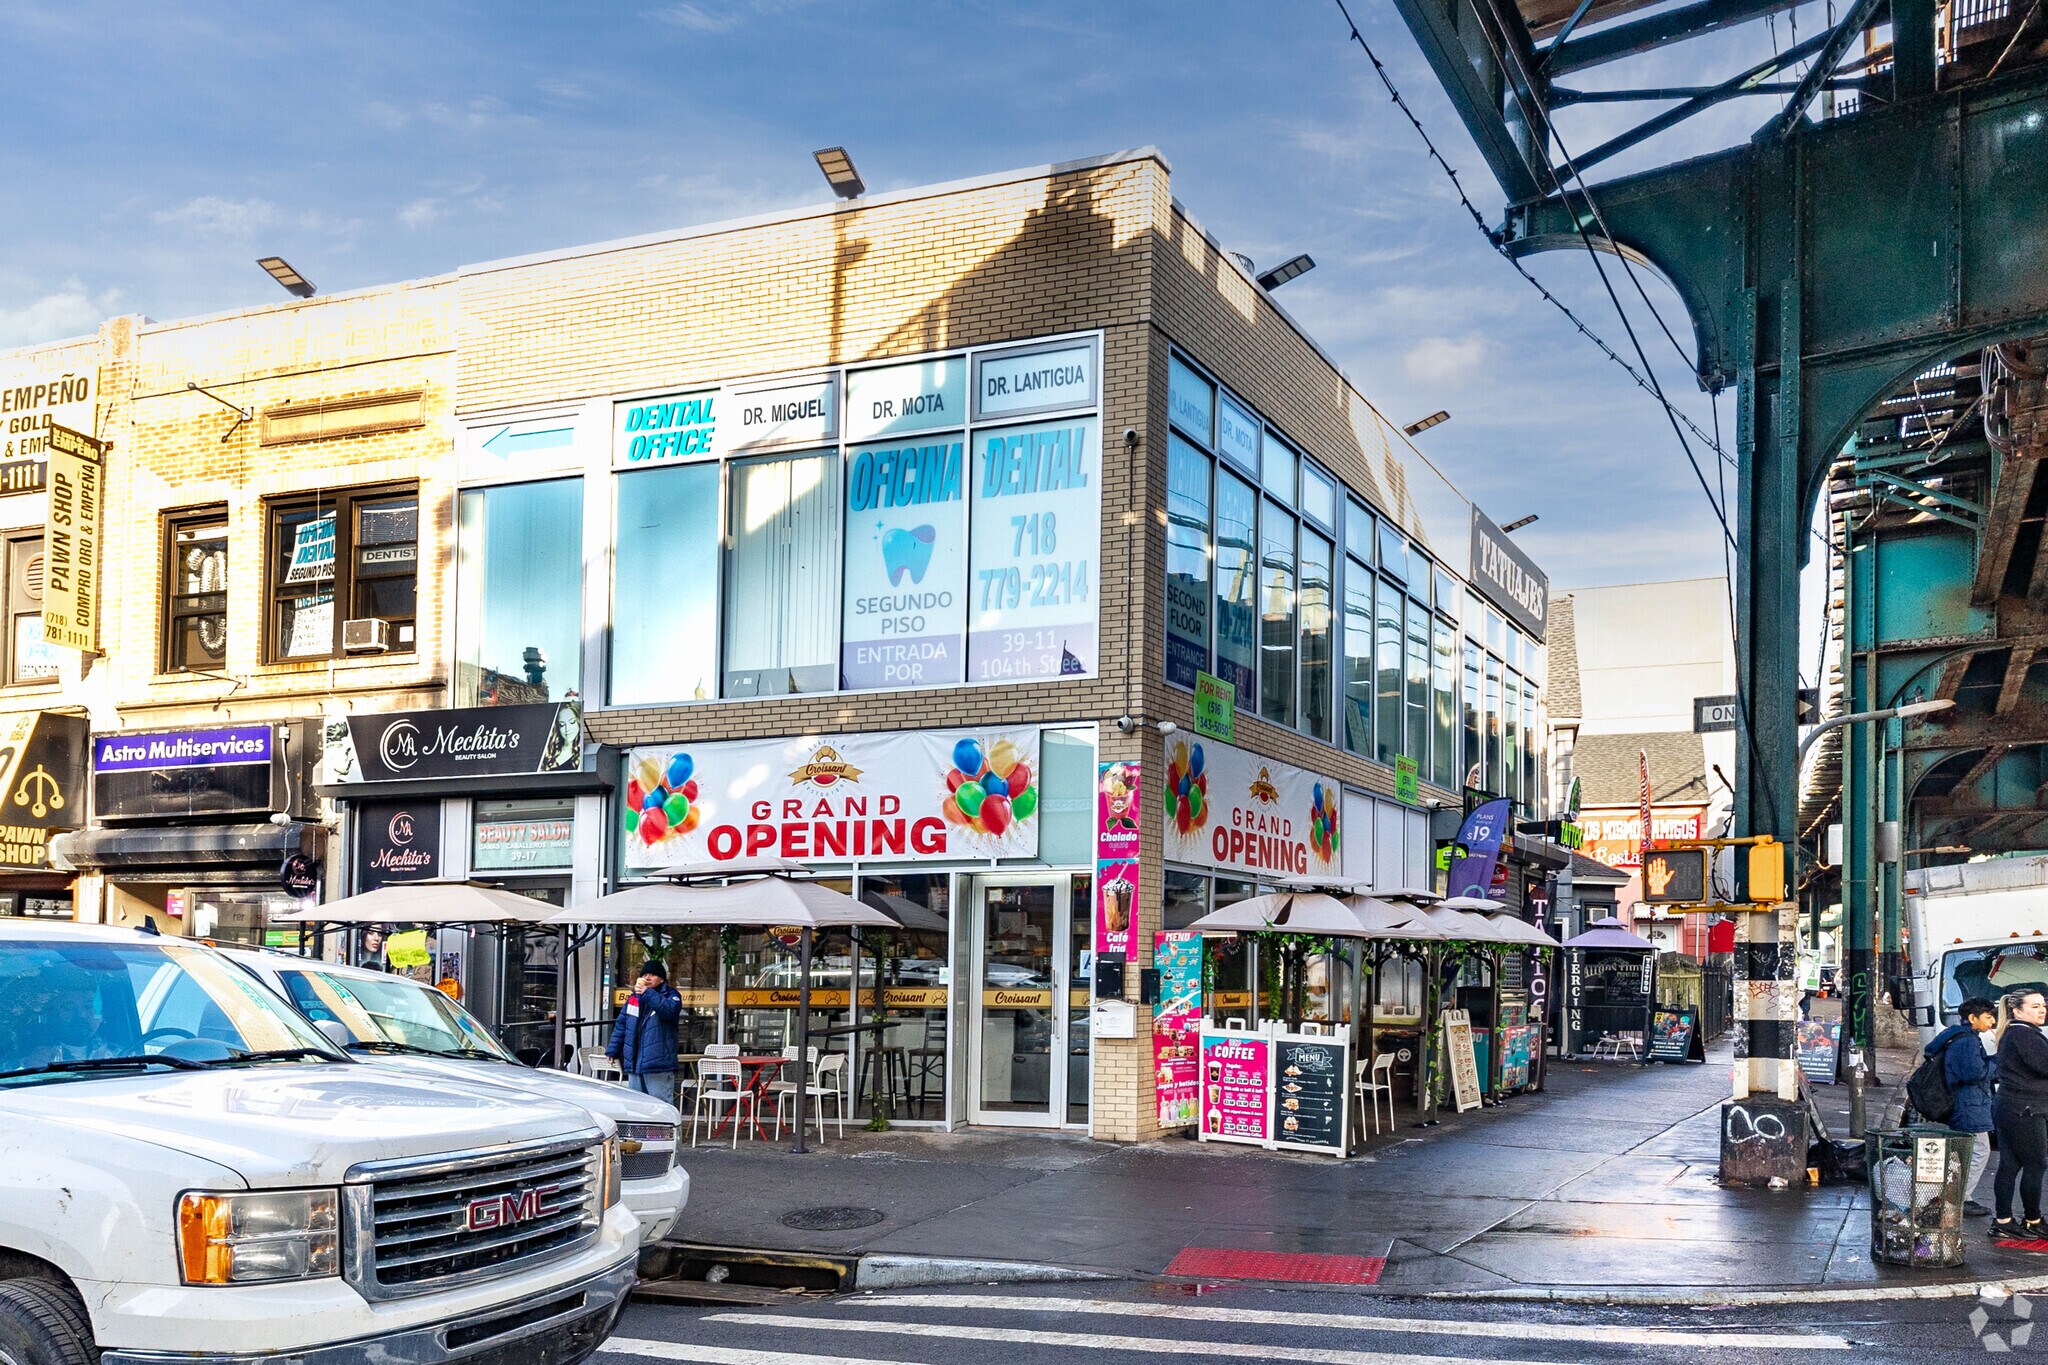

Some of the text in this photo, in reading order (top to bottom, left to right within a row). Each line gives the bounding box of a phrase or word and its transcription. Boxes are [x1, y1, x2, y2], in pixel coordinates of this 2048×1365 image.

[2, 373, 89, 413] EMPEÑO
[988, 364, 1085, 397] DR. LANTIGUA
[625, 397, 716, 433] DENTAL
[743, 398, 826, 426] DR. MIGUEL
[872, 393, 945, 420] DR. MOTA
[10, 413, 52, 434] GOLD
[5, 441, 14, 457] &
[53, 434, 98, 461] EMPEÑO
[628, 426, 713, 462] OFFICE
[1235, 426, 1253, 454] MOTA
[982, 426, 1087, 498] DENTAL
[850, 442, 962, 511] OFICINA
[51, 472, 73, 592] PAWN SHOP
[1011, 511, 1056, 557] 718
[77, 465, 95, 627] COMPRO ORO & EMPEÑA
[979, 559, 1088, 611] 779-2214
[1479, 532, 1544, 622] TATUAJES
[855, 591, 952, 616] SEGUNDO
[1167, 584, 1206, 617] SECOND
[46, 612, 67, 627] (718)
[881, 615, 926, 634] PISO
[1170, 608, 1202, 637] FLOOR
[46, 625, 88, 646] 781-1111
[1003, 630, 1055, 651] 39-11
[857, 641, 948, 665] ENTRADA
[980, 653, 1086, 678] 104th Street
[1167, 640, 1206, 668] ENTRANCE
[885, 663, 923, 681] POR
[1200, 679, 1233, 702] FOR RENT
[1207, 701, 1224, 717] (516)
[101, 735, 264, 763] Astro Multiservices
[422, 724, 520, 756] Mechita's
[454, 752, 496, 761] BEAUTY SALON
[805, 763, 847, 776] Croissant
[751, 794, 901, 821] GRAND
[1477, 813, 1494, 821] PLANS
[479, 821, 571, 843] BEAUTY SALON
[1232, 807, 1292, 838] GRAND
[1466, 826, 1490, 841] $19
[1602, 819, 1642, 840] MISMO
[707, 816, 947, 861] OPENING
[1100, 832, 1138, 842] Cholado
[370, 848, 431, 868] Mechita's
[511, 851, 537, 861] 39-17
[1212, 825, 1307, 875] OPENING
[1590, 847, 1642, 865] Resta
[1106, 932, 1128, 943] Café
[1165, 932, 1191, 942] MENU
[995, 992, 1041, 1004] Croissant
[1570, 946, 1581, 1031] IERCING
[1214, 1046, 1255, 1061] COFFEE
[1298, 1053, 1321, 1062] MENU
[467, 1182, 560, 1232] GMC
